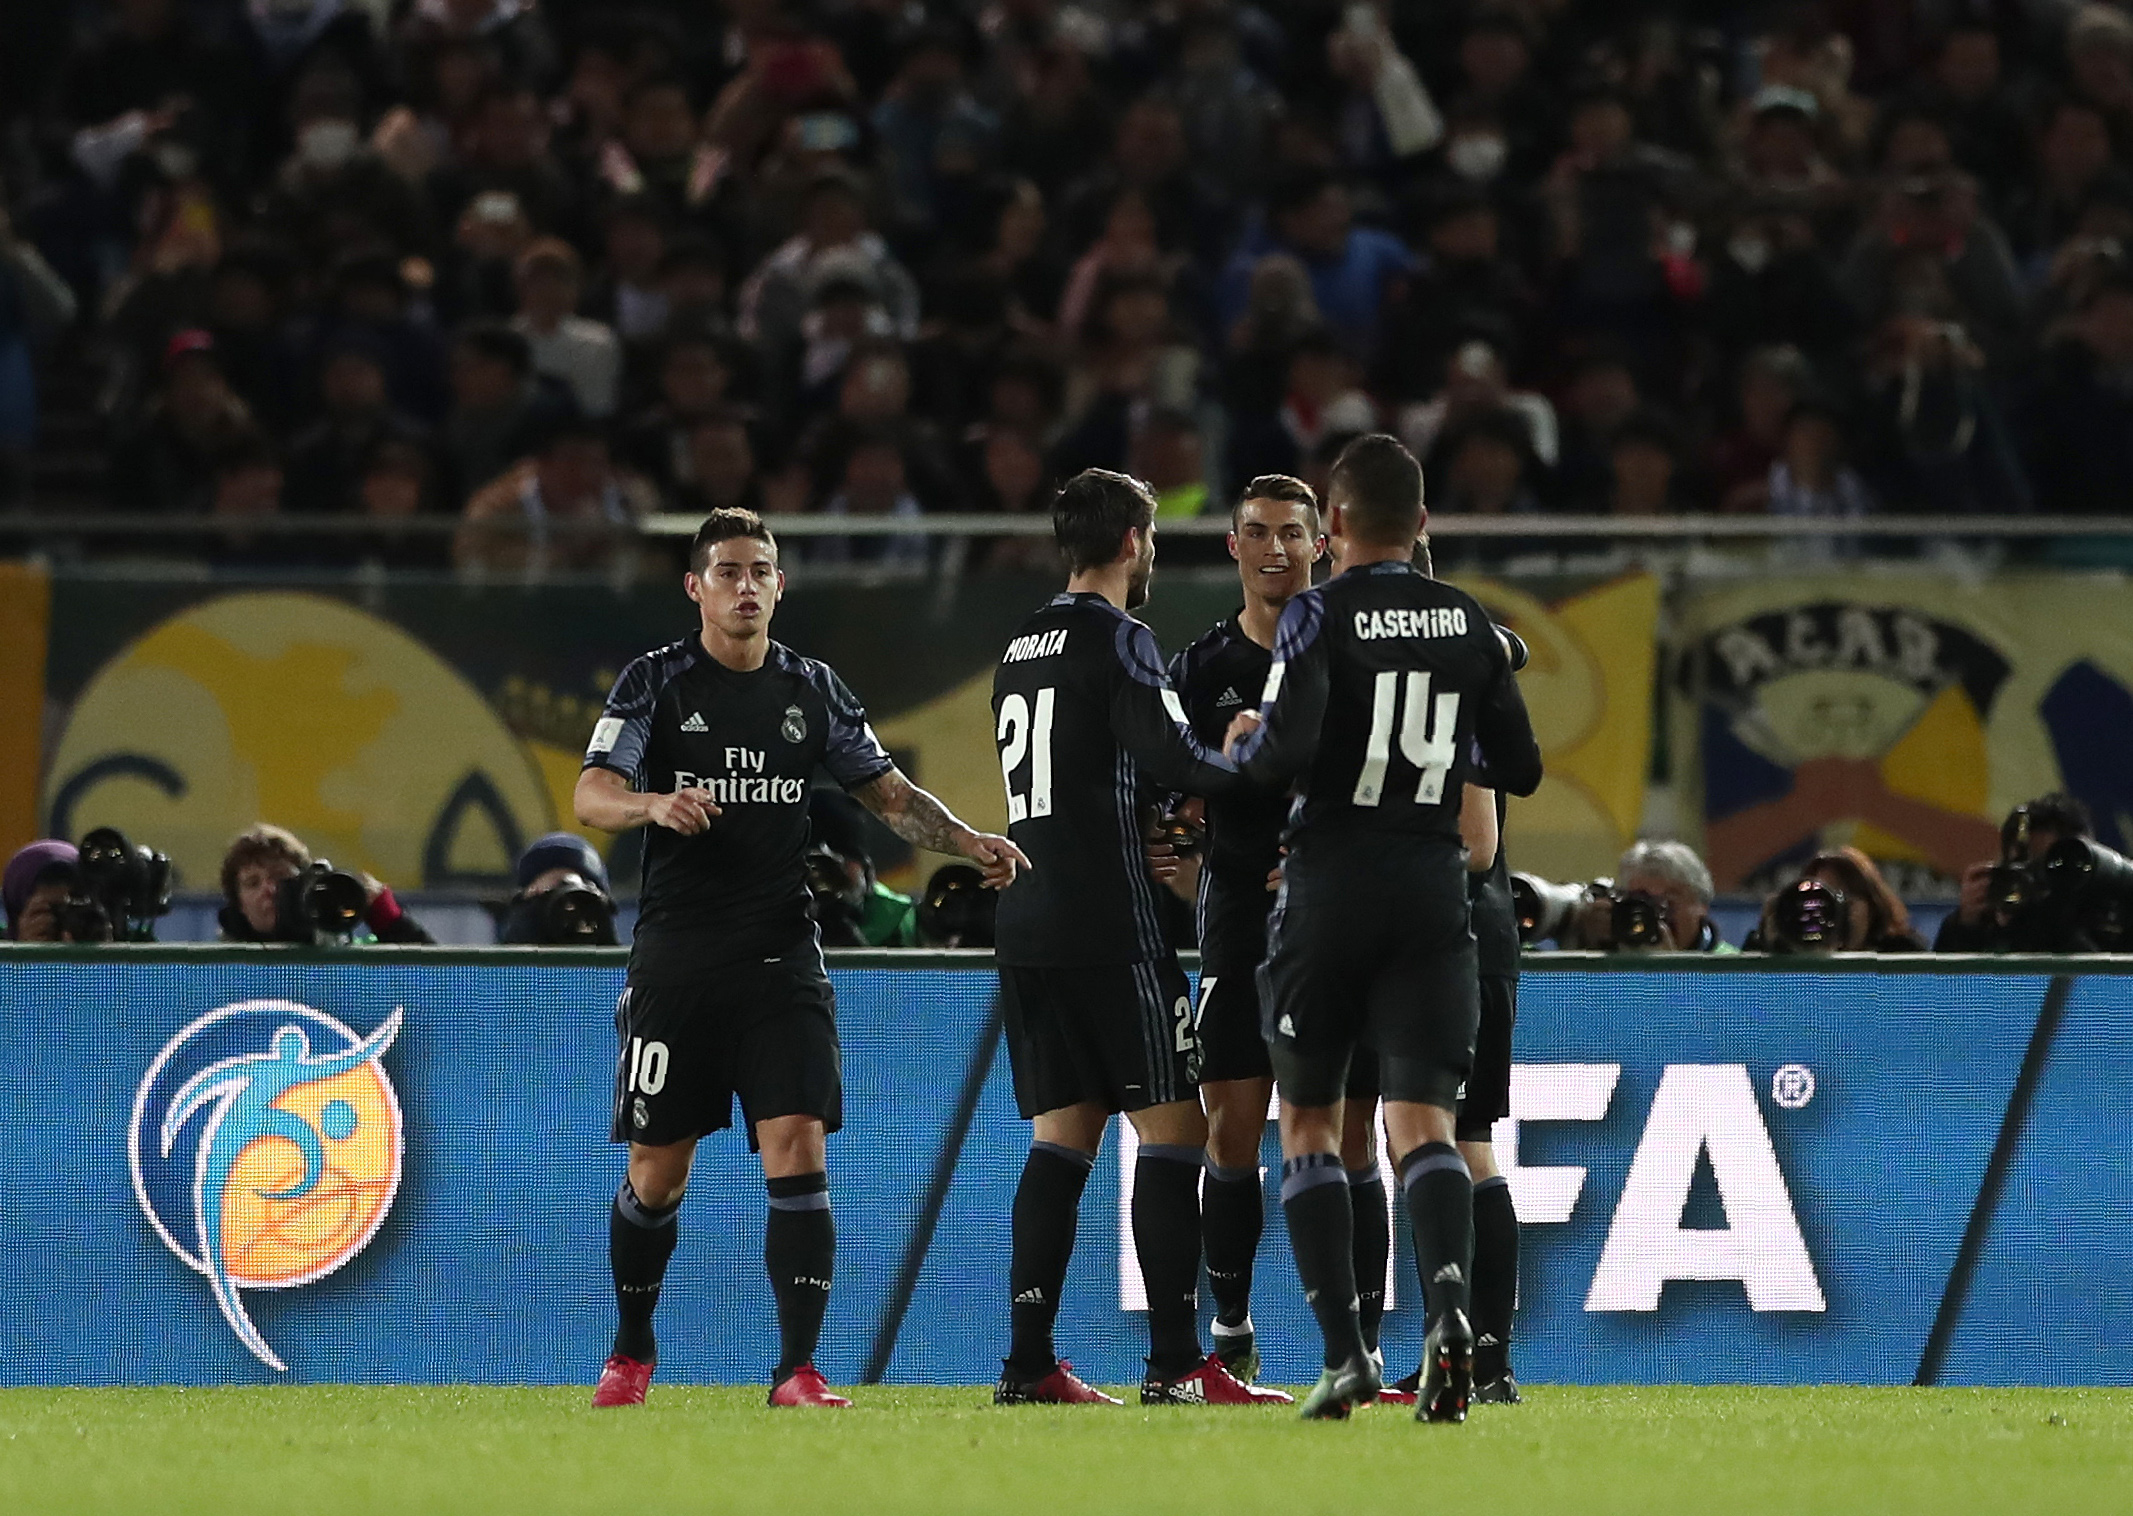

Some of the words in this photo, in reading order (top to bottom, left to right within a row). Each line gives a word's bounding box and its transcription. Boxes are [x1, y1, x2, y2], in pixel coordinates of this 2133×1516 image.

[1003, 629, 1069, 664] MORATA
[724, 747, 766, 773] Fly
[997, 687, 1055, 826] 21
[1353, 671, 1461, 807] 14
[674, 771, 805, 804] Emirates
[1193, 976, 1219, 1032] 7
[628, 1036, 670, 1096] 10
